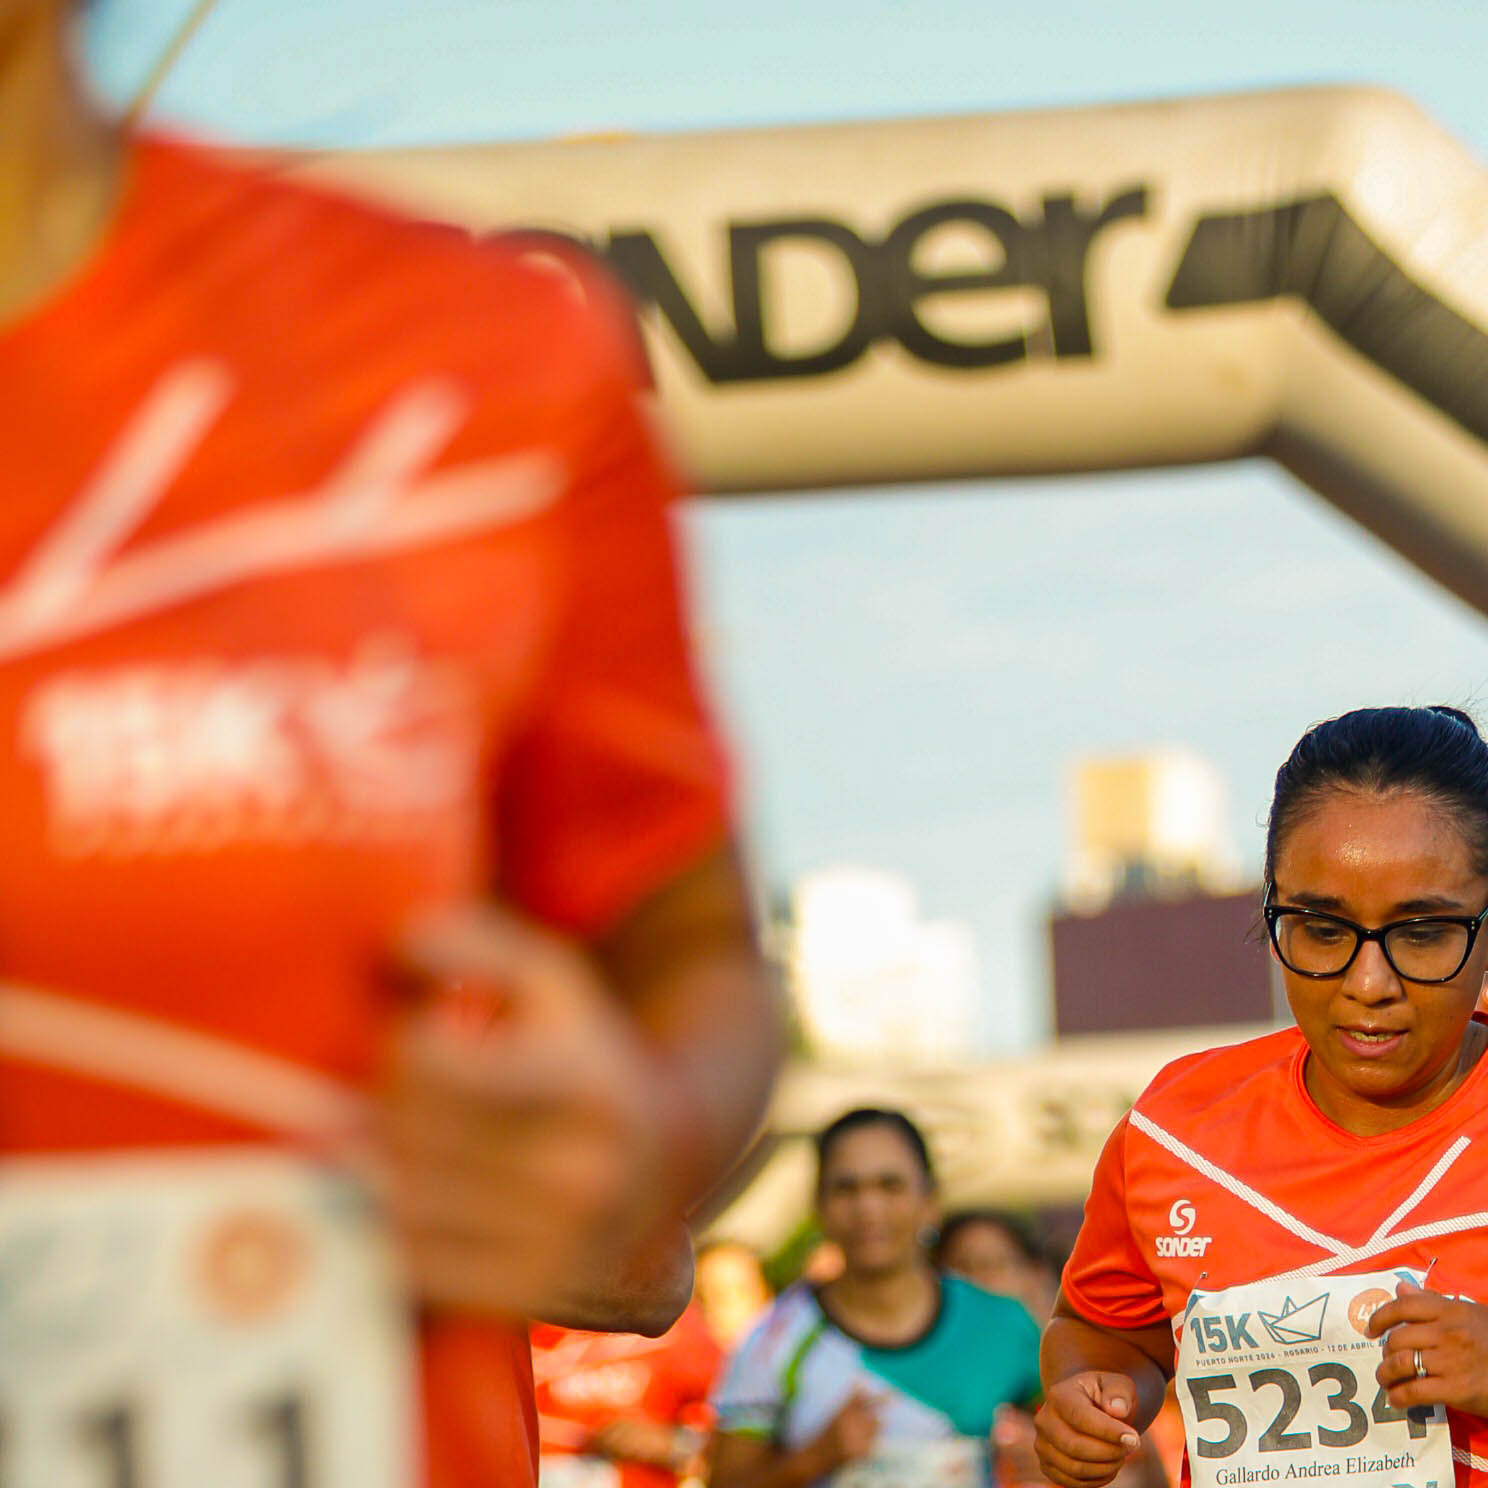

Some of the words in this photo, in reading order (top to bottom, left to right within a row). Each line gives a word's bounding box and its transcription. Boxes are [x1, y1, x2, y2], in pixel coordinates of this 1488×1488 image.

[1190, 1311, 1259, 1353] 15K
[1196, 1357, 1226, 1367] PUERTO
[1228, 1354, 1254, 1364] NORTE
[1284, 1346, 1319, 1357] ROSARIO
[1337, 1343, 1347, 1352] DE
[1350, 1341, 1374, 1351] ABRIL
[1216, 1464, 1280, 1486] Gallardo
[1285, 1460, 1341, 1480] Andrea
[1346, 1452, 1415, 1475] Elizabeth
